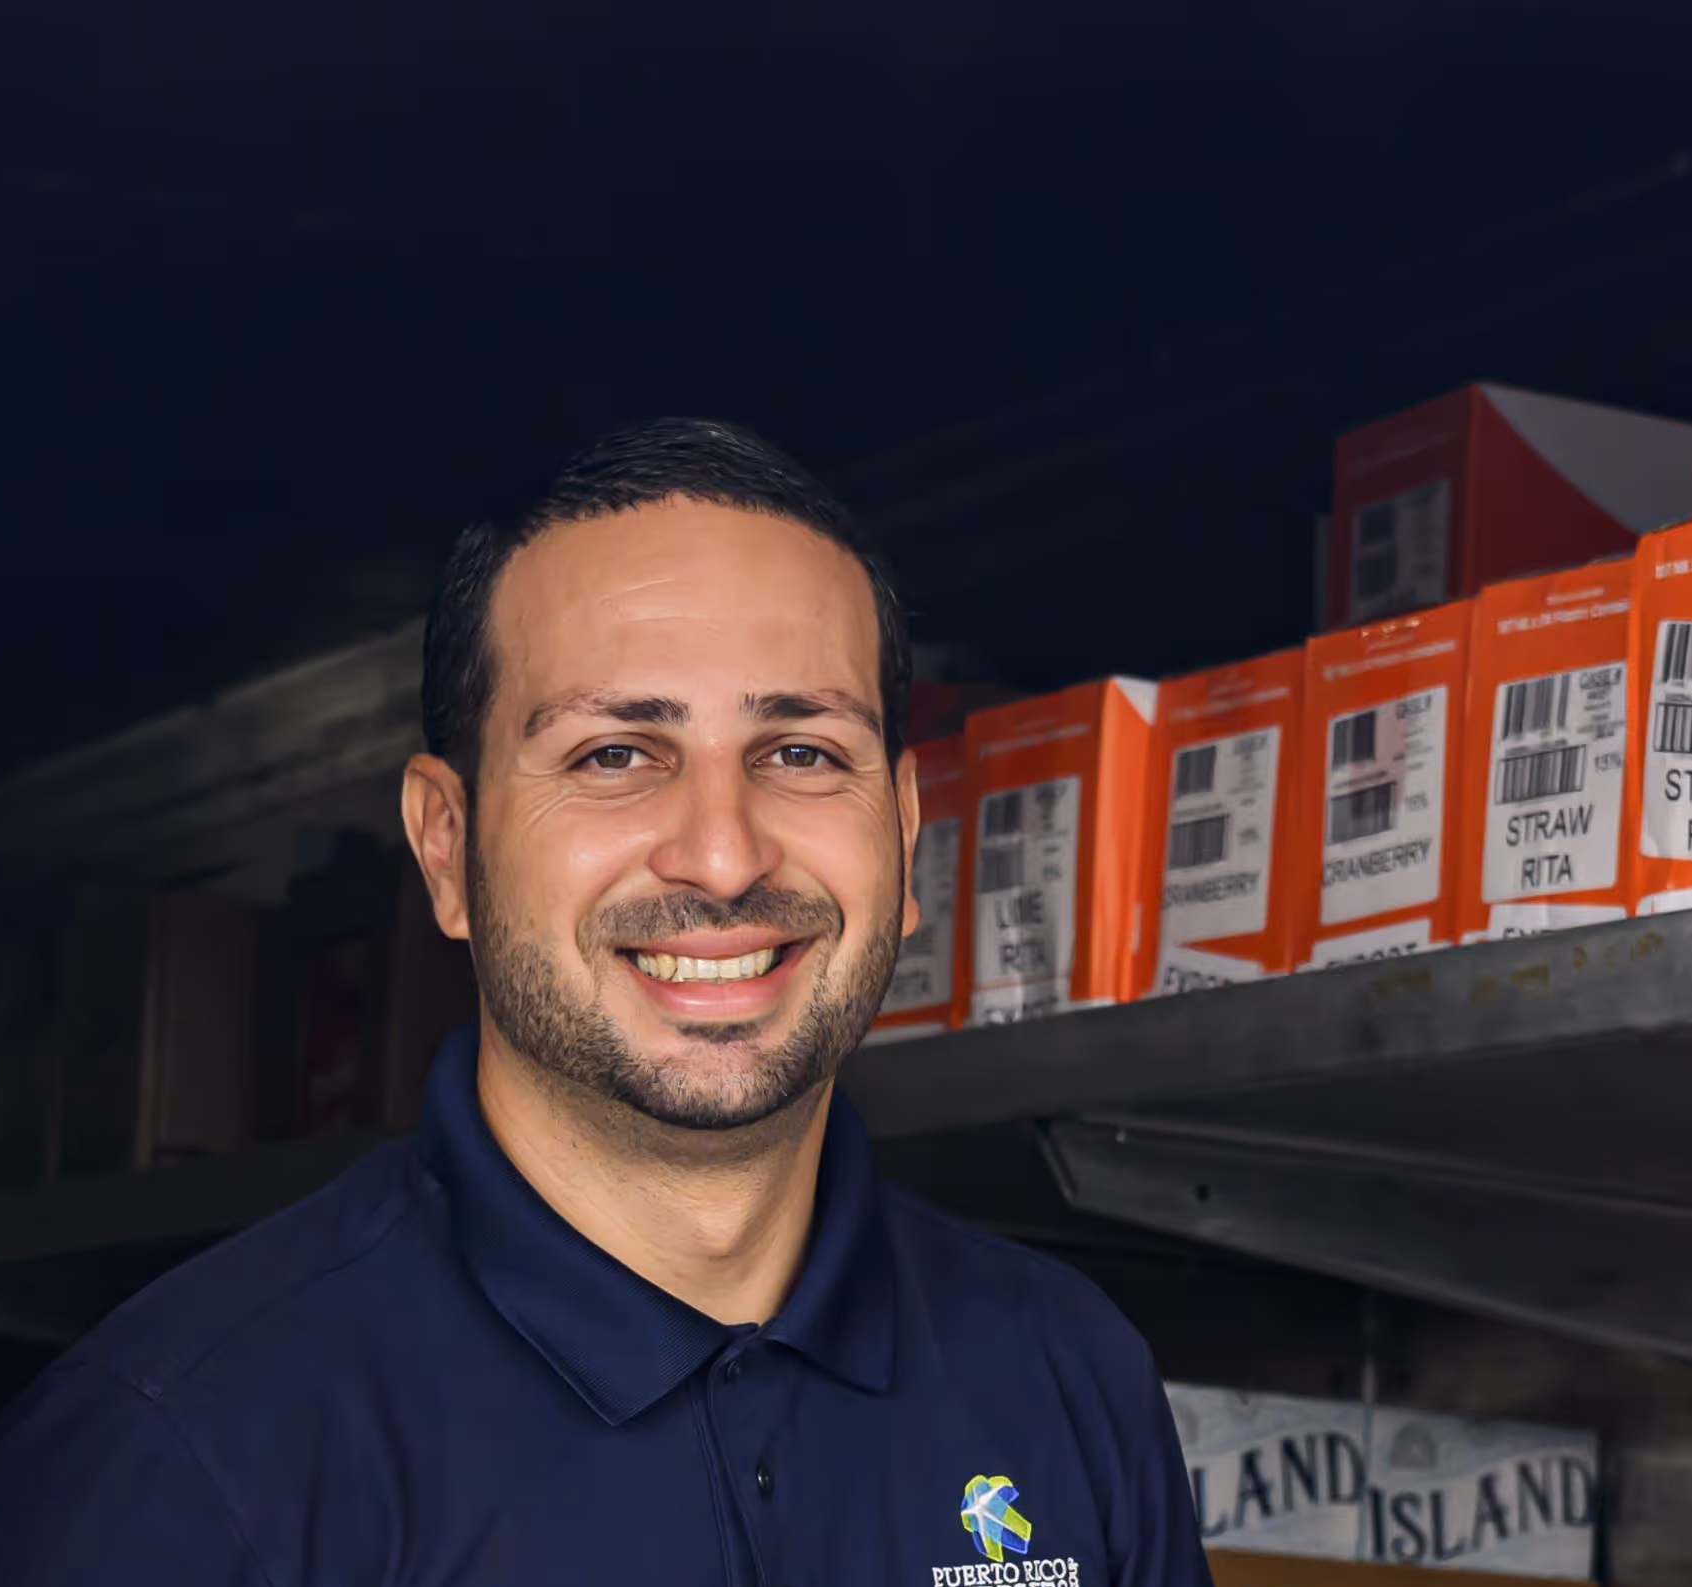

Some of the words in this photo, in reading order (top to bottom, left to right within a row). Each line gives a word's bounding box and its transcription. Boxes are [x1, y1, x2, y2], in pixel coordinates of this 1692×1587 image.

[1506, 803, 1595, 847] STRAW
[1521, 854, 1573, 889] RITA
[1367, 1454, 1599, 1564] ISLAND
[1022, 1557, 1066, 1582] RICO
